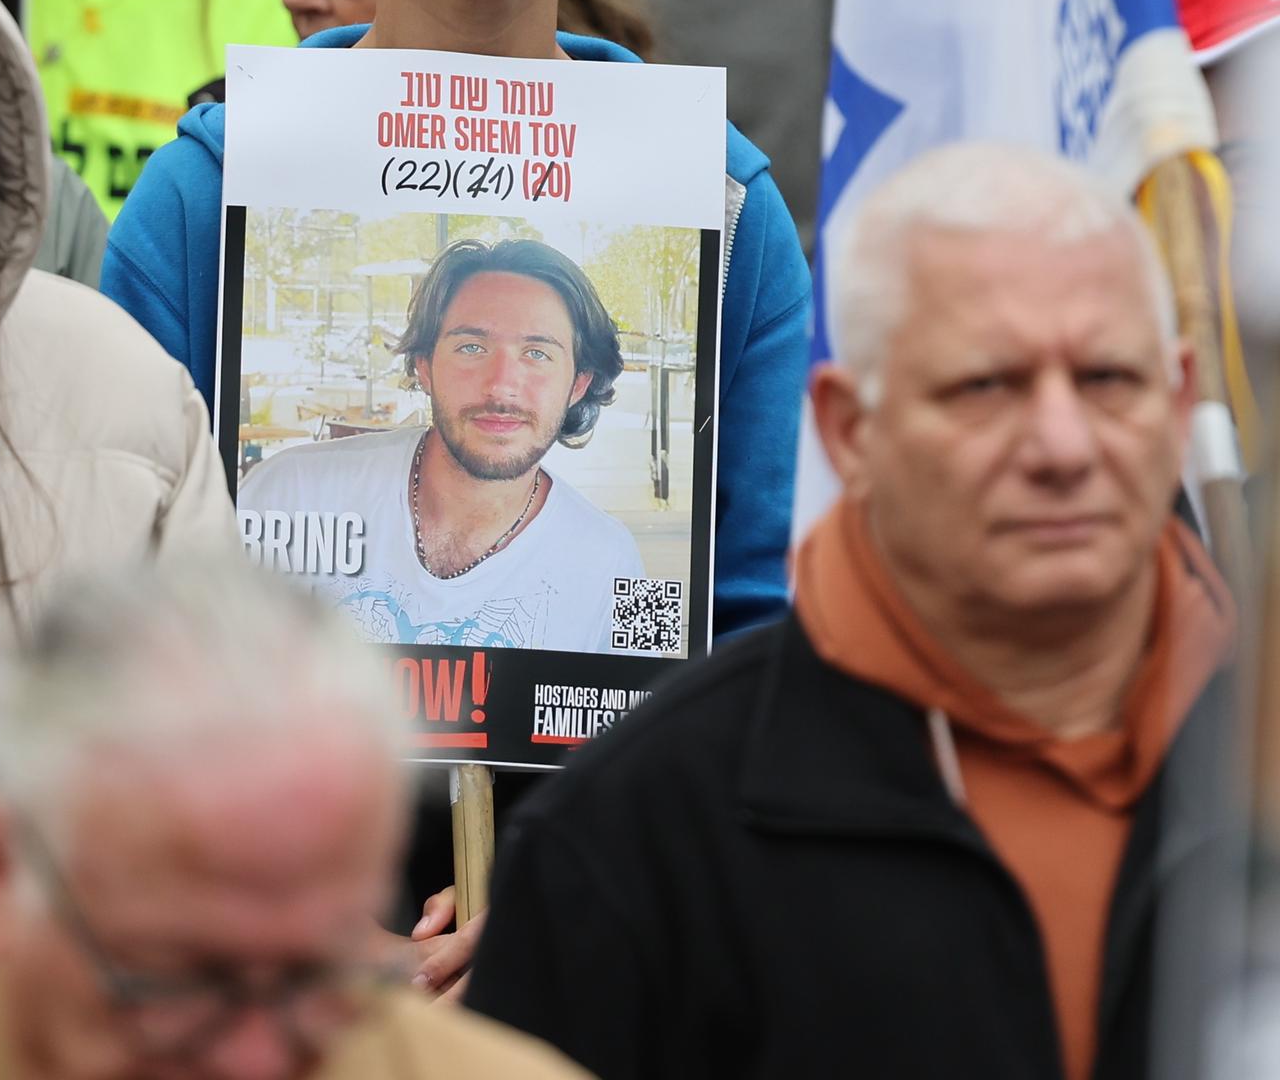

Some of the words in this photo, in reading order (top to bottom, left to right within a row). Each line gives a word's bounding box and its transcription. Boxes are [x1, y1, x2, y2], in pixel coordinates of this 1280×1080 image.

[400, 71, 442, 108] טוב
[449, 74, 488, 112] שם
[495, 78, 554, 117] עומר
[377, 111, 446, 150] OMER
[454, 115, 521, 155] SHEM
[528, 121, 577, 159] TOV
[522, 158, 572, 203] (20)
[237, 509, 365, 576] BRING
[384, 651, 489, 724] OW!
[535, 683, 599, 709] HOSTAGES
[600, 688, 626, 710] AND
[533, 705, 615, 739] FAMILIES
